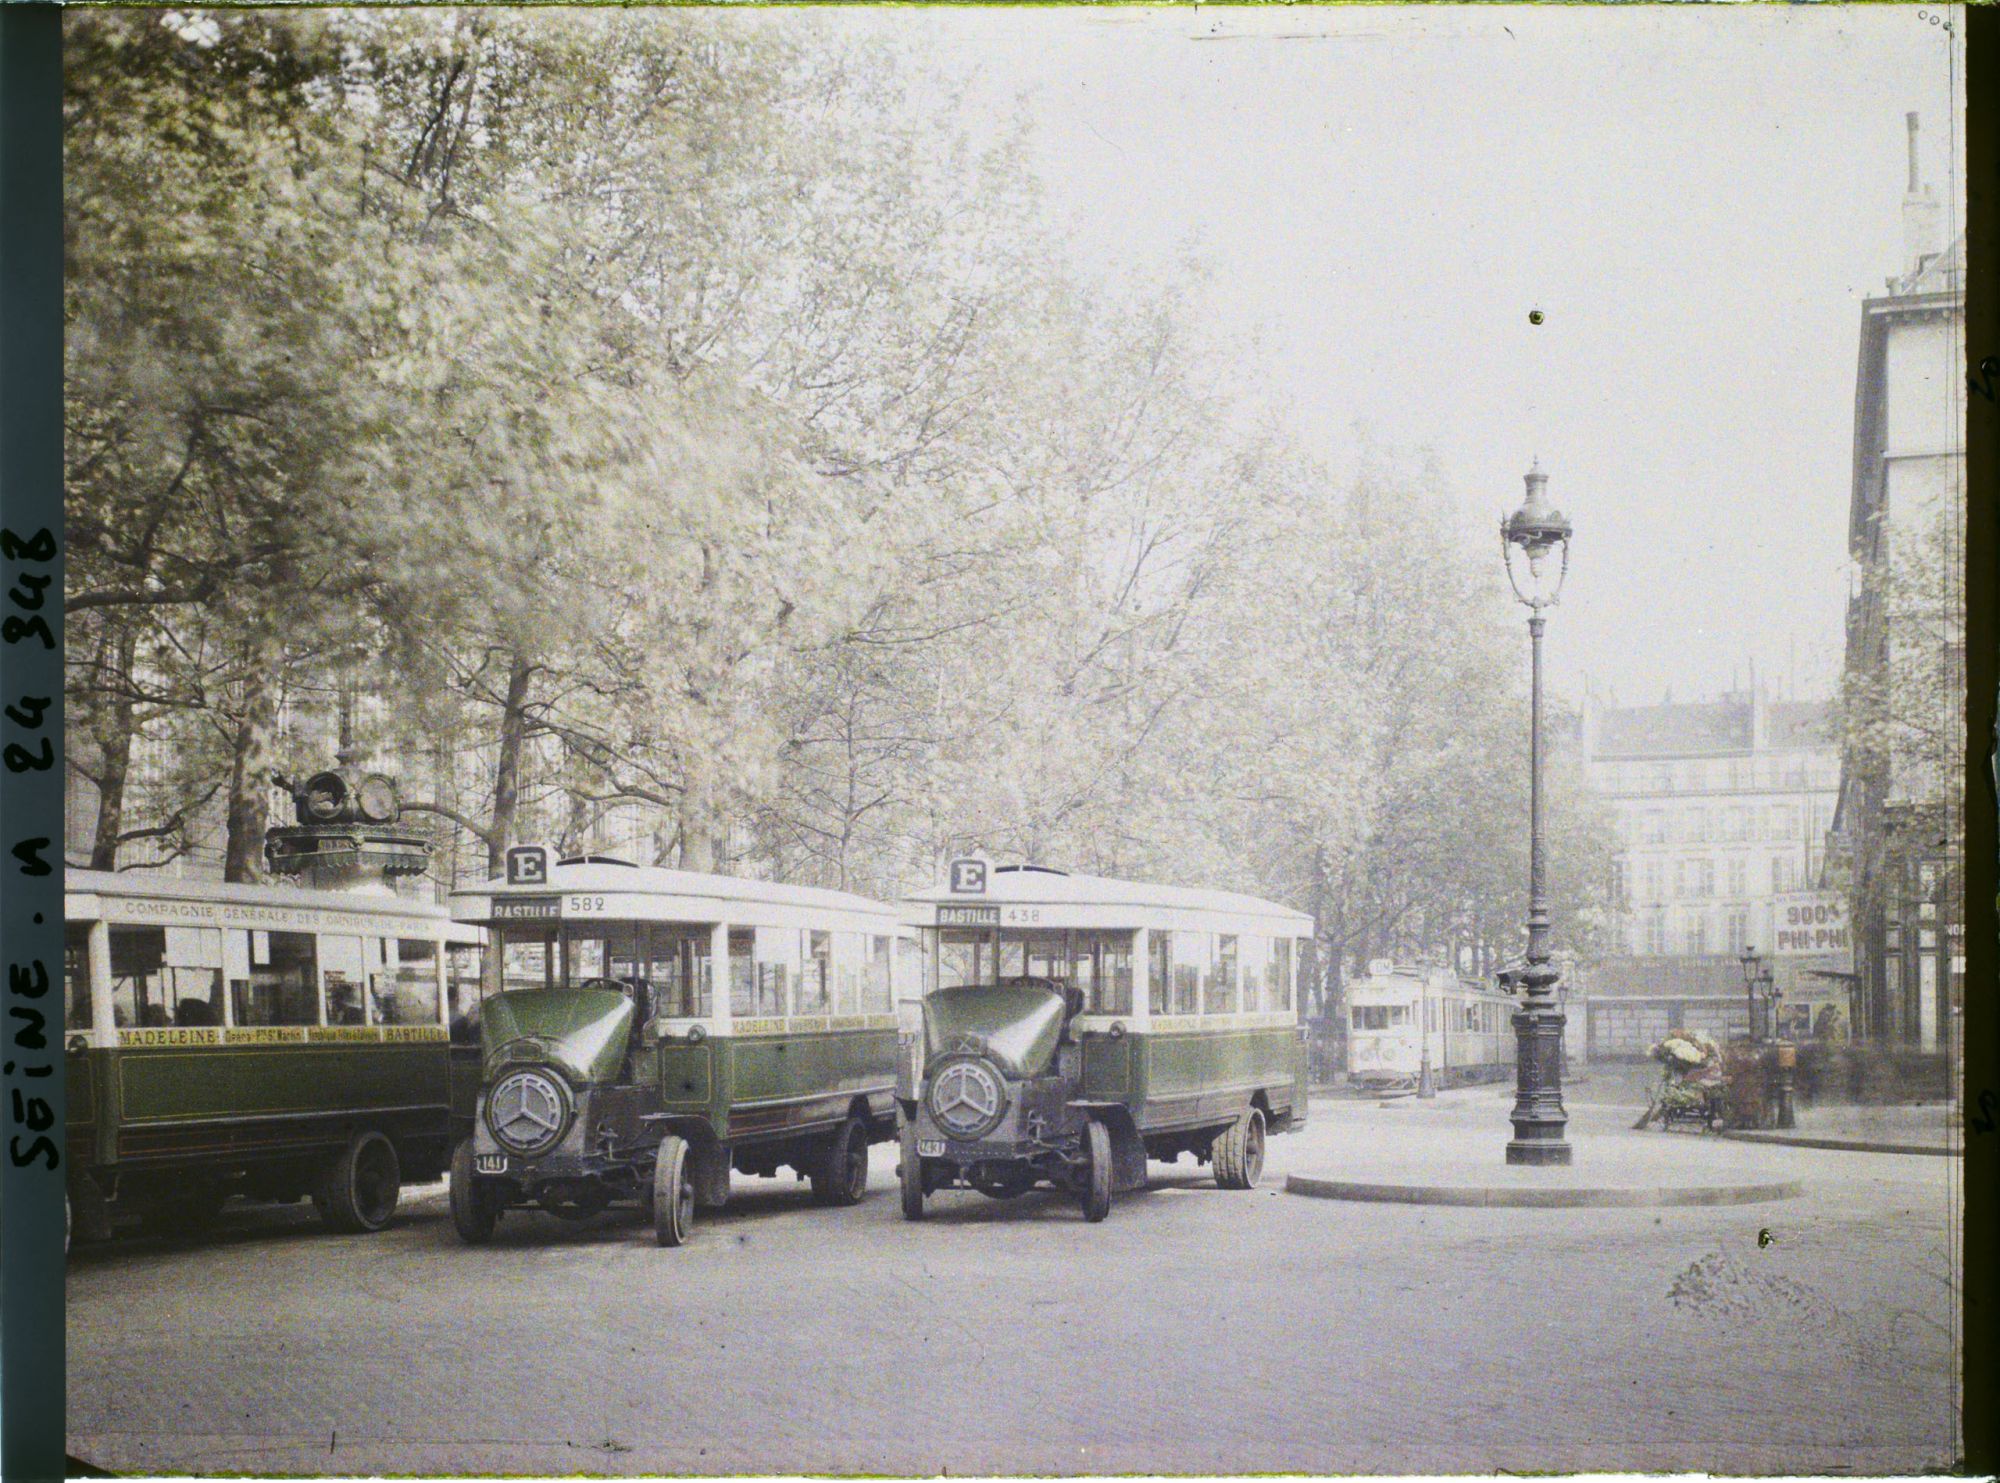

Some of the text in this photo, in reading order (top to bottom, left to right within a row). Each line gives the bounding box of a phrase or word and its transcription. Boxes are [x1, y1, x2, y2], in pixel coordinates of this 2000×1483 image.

[0, 528, 58, 650] 348
[3, 695, 55, 773] 24
[513, 852, 542, 881] E
[956, 863, 983, 890] E
[124, 901, 215, 918] COMPAGNIE
[940, 908, 998, 924] BASTILLE
[1007, 909, 1040, 923] 438
[1777, 929, 1849, 950] PHI-PHI
[118, 1029, 218, 1046] MADELEINE
